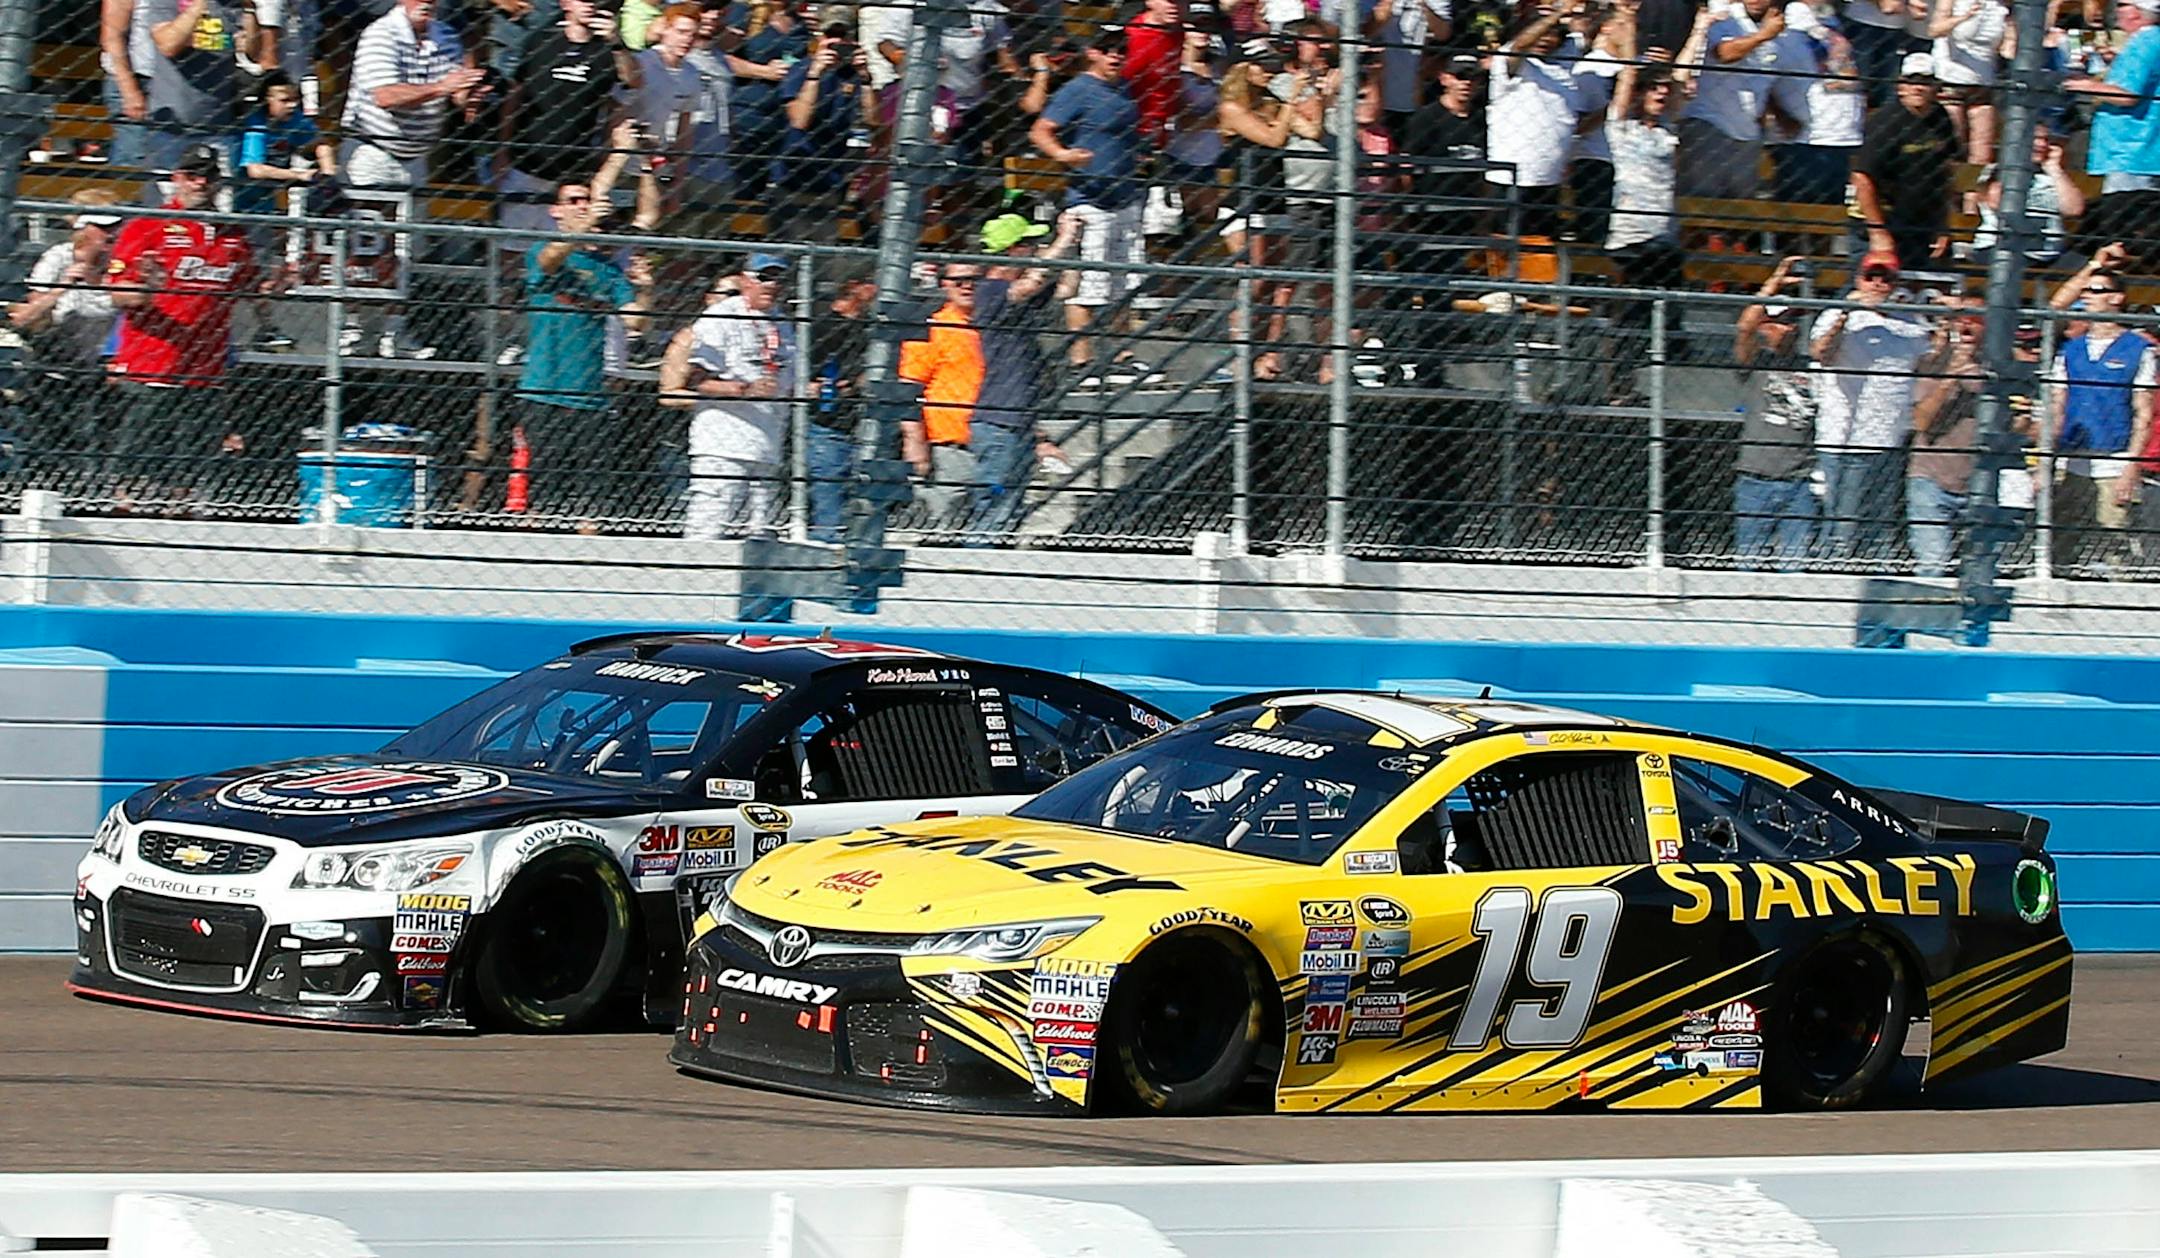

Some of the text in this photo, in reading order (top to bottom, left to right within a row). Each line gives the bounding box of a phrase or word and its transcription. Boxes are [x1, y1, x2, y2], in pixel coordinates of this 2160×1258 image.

[595, 661, 706, 685] HARVICK
[1214, 732, 1335, 760] EDWARDS
[1641, 770, 1671, 778] TOYOTA
[639, 825, 679, 852] 3M
[685, 851, 720, 868] Mobil
[126, 872, 257, 899] CHEVROLET SS
[1656, 854, 1976, 924] STANLEY
[398, 894, 470, 911] MOOG
[396, 914, 461, 932] MAHLE
[1038, 958, 1113, 978] MOOG
[1303, 953, 1341, 969] Mobil
[1446, 886, 1622, 1052] 19
[717, 968, 838, 1004] CAMRY
[1033, 978, 1108, 999] MAHLE
[1031, 1001, 1085, 1017] COMP
[1356, 995, 1398, 1006] LINCOLN
[1304, 1004, 1344, 1032] 3M
[1717, 1001, 1756, 1023] MAC
[1719, 1023, 1756, 1031] TOOLS
[1049, 1058, 1094, 1069] SUNOCO
